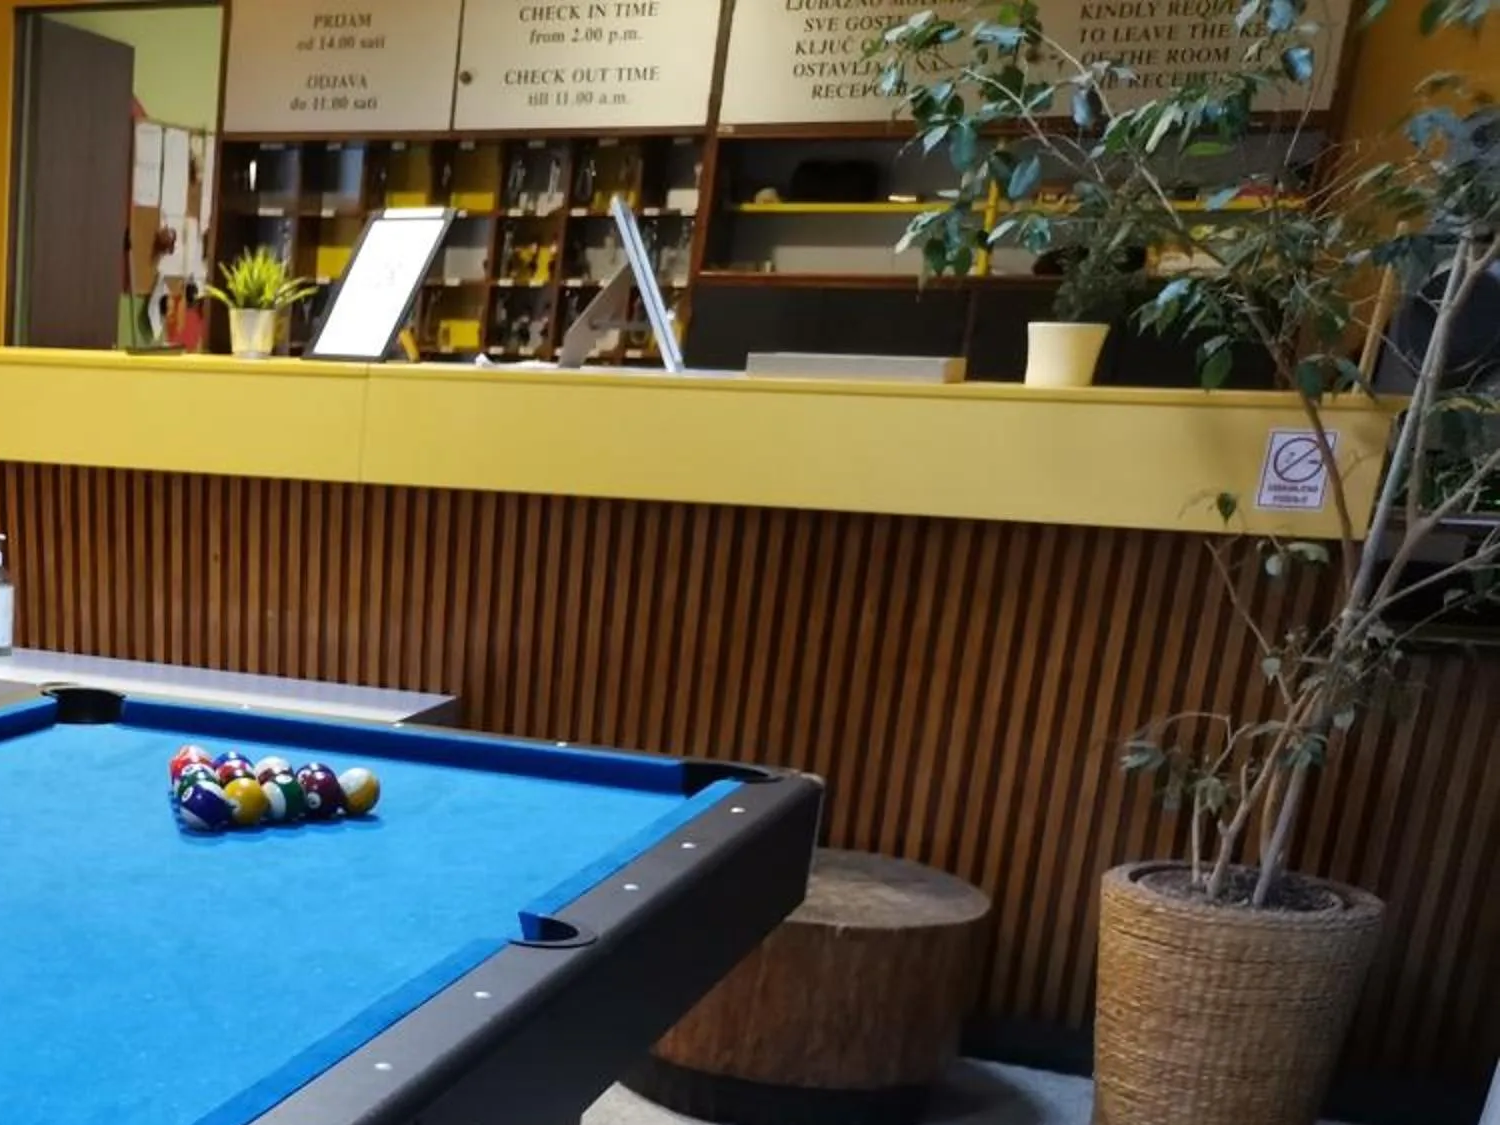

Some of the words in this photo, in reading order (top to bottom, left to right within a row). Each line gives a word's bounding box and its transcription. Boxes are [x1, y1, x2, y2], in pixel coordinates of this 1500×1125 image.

[519, 4, 581, 22] CHECK
[587, 3, 607, 20] IN
[614, 1, 661, 18] TIME
[1080, 0, 1158, 19] KINDLY
[804, 16, 840, 33] SVE
[1112, 25, 1175, 43] LEAVE
[1187, 23, 1230, 39] THE
[529, 27, 566, 45] from
[571, 26, 603, 43] 2.00
[1166, 46, 1230, 65] ROOM
[504, 67, 566, 86] CHECK
[572, 66, 610, 84] OUT
[617, 65, 660, 82] TIME
[528, 90, 550, 106] till
